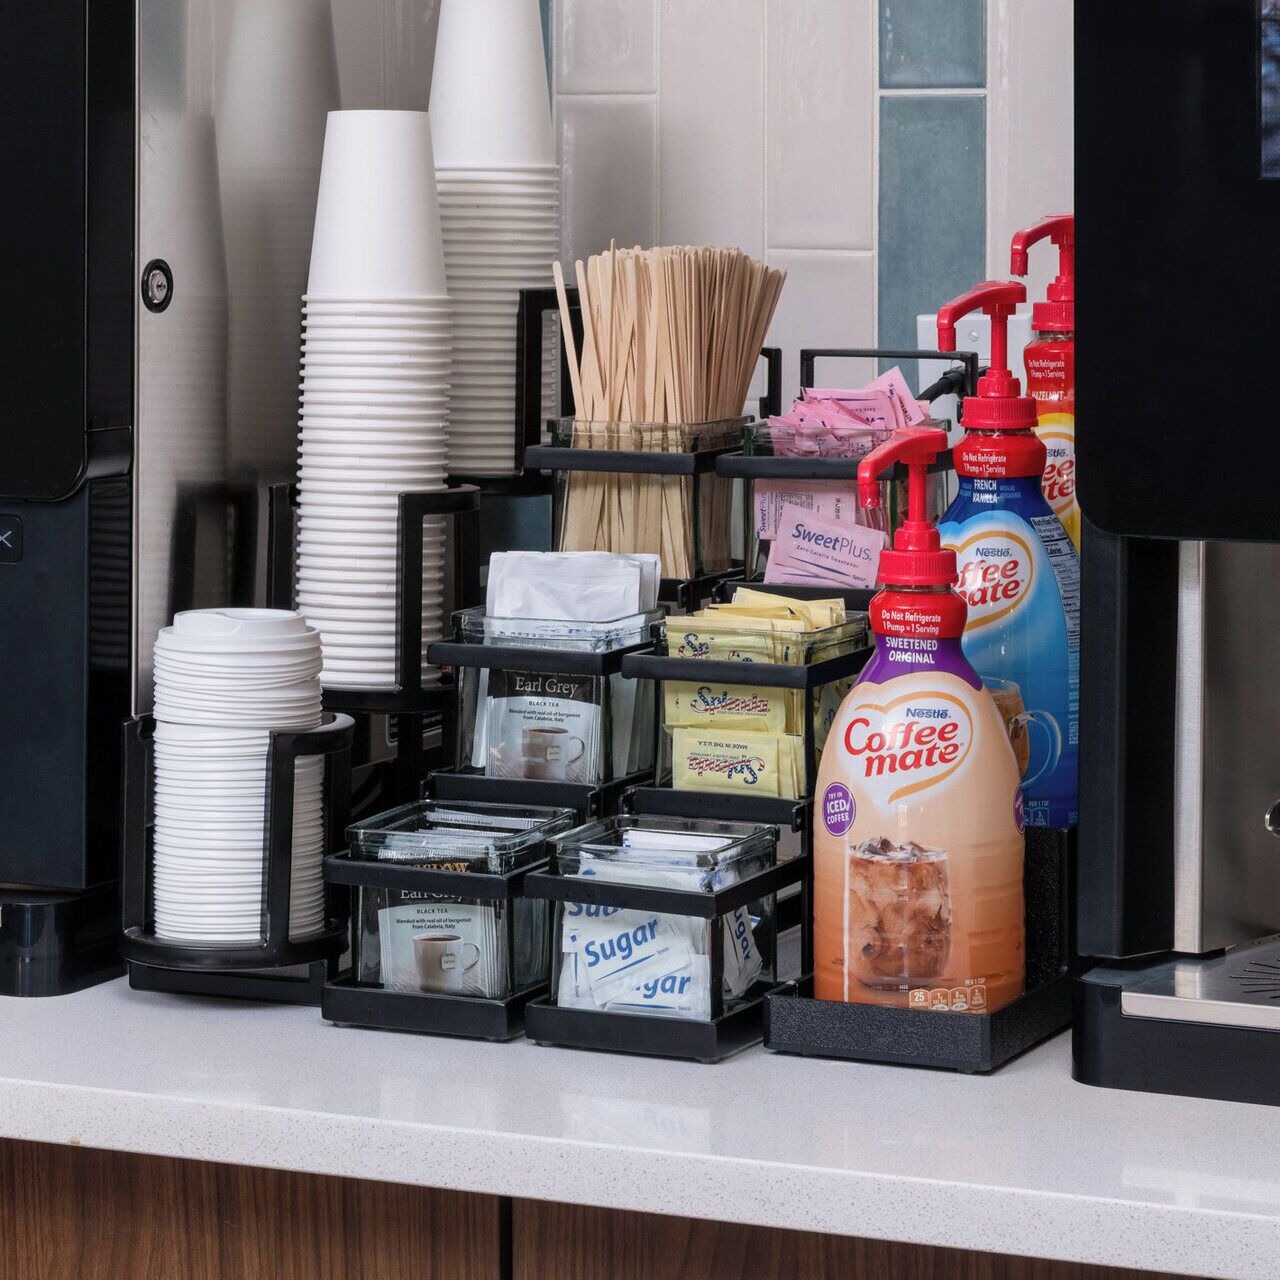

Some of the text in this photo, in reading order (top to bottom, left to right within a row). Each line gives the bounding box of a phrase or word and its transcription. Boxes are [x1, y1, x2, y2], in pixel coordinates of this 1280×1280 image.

[978, 453, 1007, 464] Refrigerate
[986, 464, 1006, 476] Serving
[974, 479, 997, 490] FRENCH
[792, 523, 871, 561] SweetPlus
[975, 547, 1011, 557] Nestlé
[951, 560, 1019, 588] ffee
[959, 579, 1021, 607] ate
[882, 609, 941, 624] Do Not Refrigerate
[887, 621, 905, 633] Pump
[911, 623, 915, 632] 1
[915, 624, 940, 635] Serving
[885, 636, 938, 651] SWEETENED
[889, 650, 935, 664] ORIGINAL
[515, 676, 579, 698] Earl Grey
[691, 686, 769, 716] Splenda
[906, 707, 948, 719] Nestlé
[844, 717, 959, 756] Coffee
[713, 741, 724, 749] THE
[732, 743, 749, 751] MADE
[864, 742, 960, 777] mate
[826, 799, 847, 815] ICED
[827, 812, 850, 825] COFFEE
[585, 919, 658, 968] Sugar
[914, 991, 925, 1002] 25
